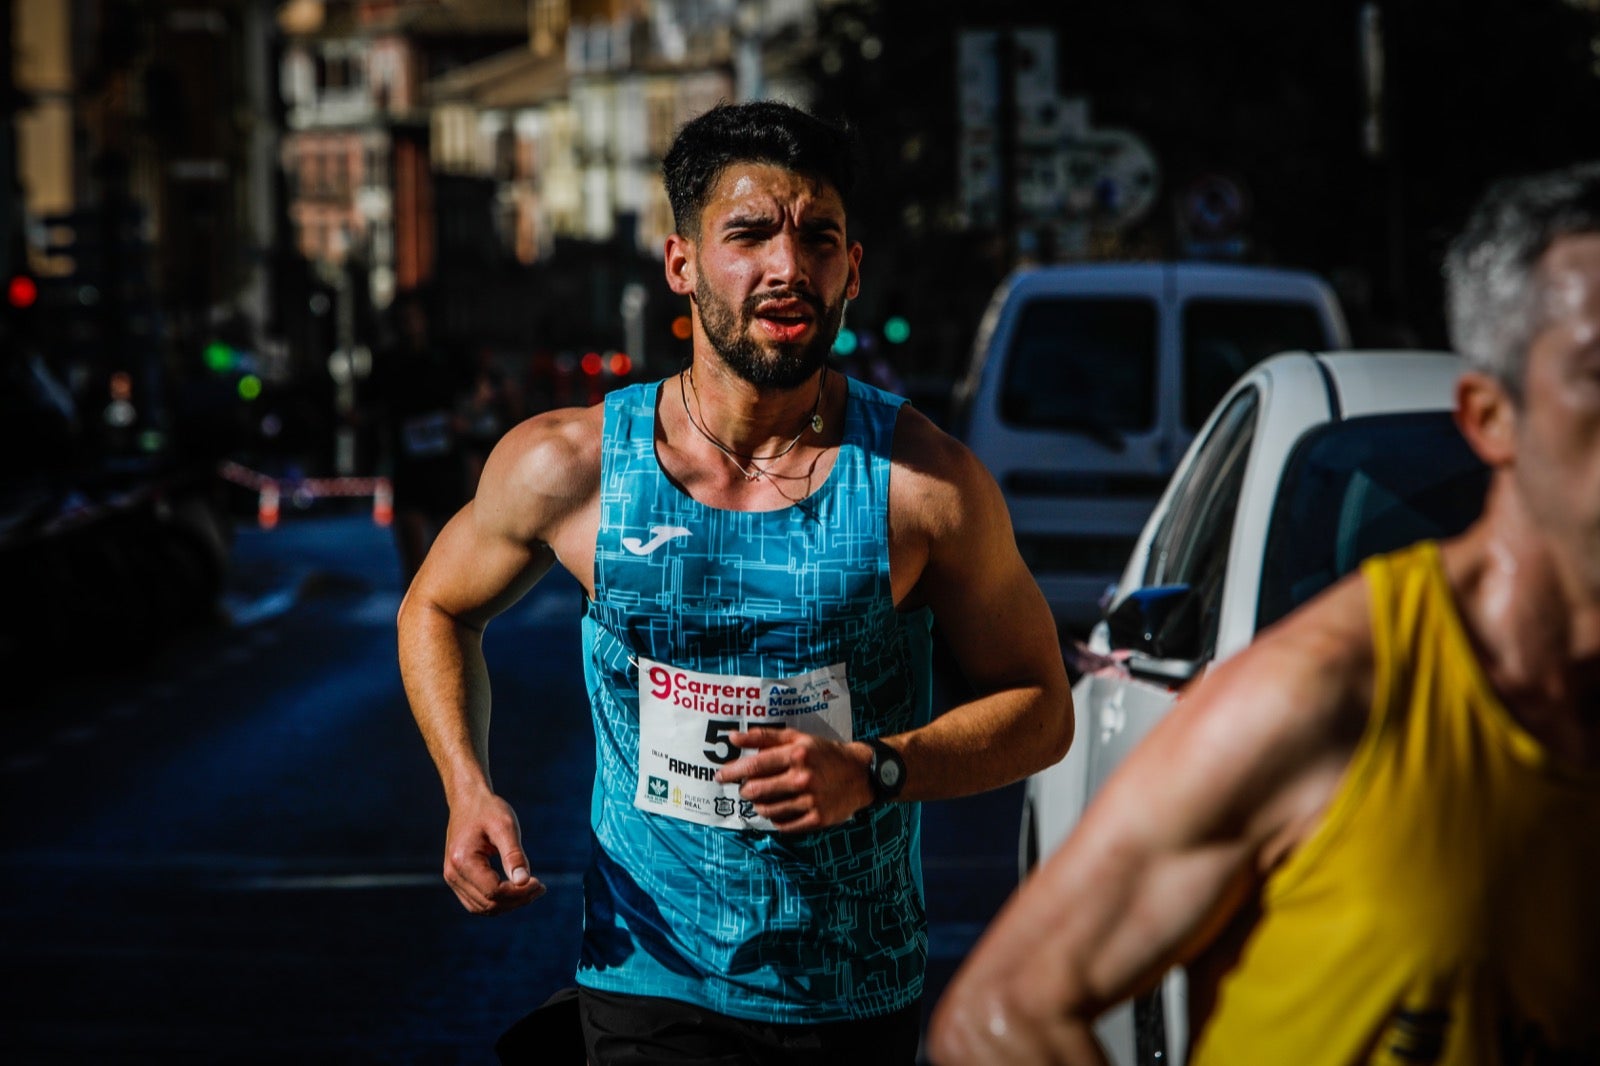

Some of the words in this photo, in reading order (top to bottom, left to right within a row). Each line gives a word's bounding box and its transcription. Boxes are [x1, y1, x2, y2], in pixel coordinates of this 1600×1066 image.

[649, 666, 672, 700] 9
[674, 672, 761, 699] Carrera
[769, 685, 797, 695] Ave
[673, 689, 766, 717] Solidaria
[768, 701, 829, 717] Granada
[703, 719, 787, 765] 5
[669, 757, 742, 784] ARMAN
[684, 800, 702, 810] REAL
